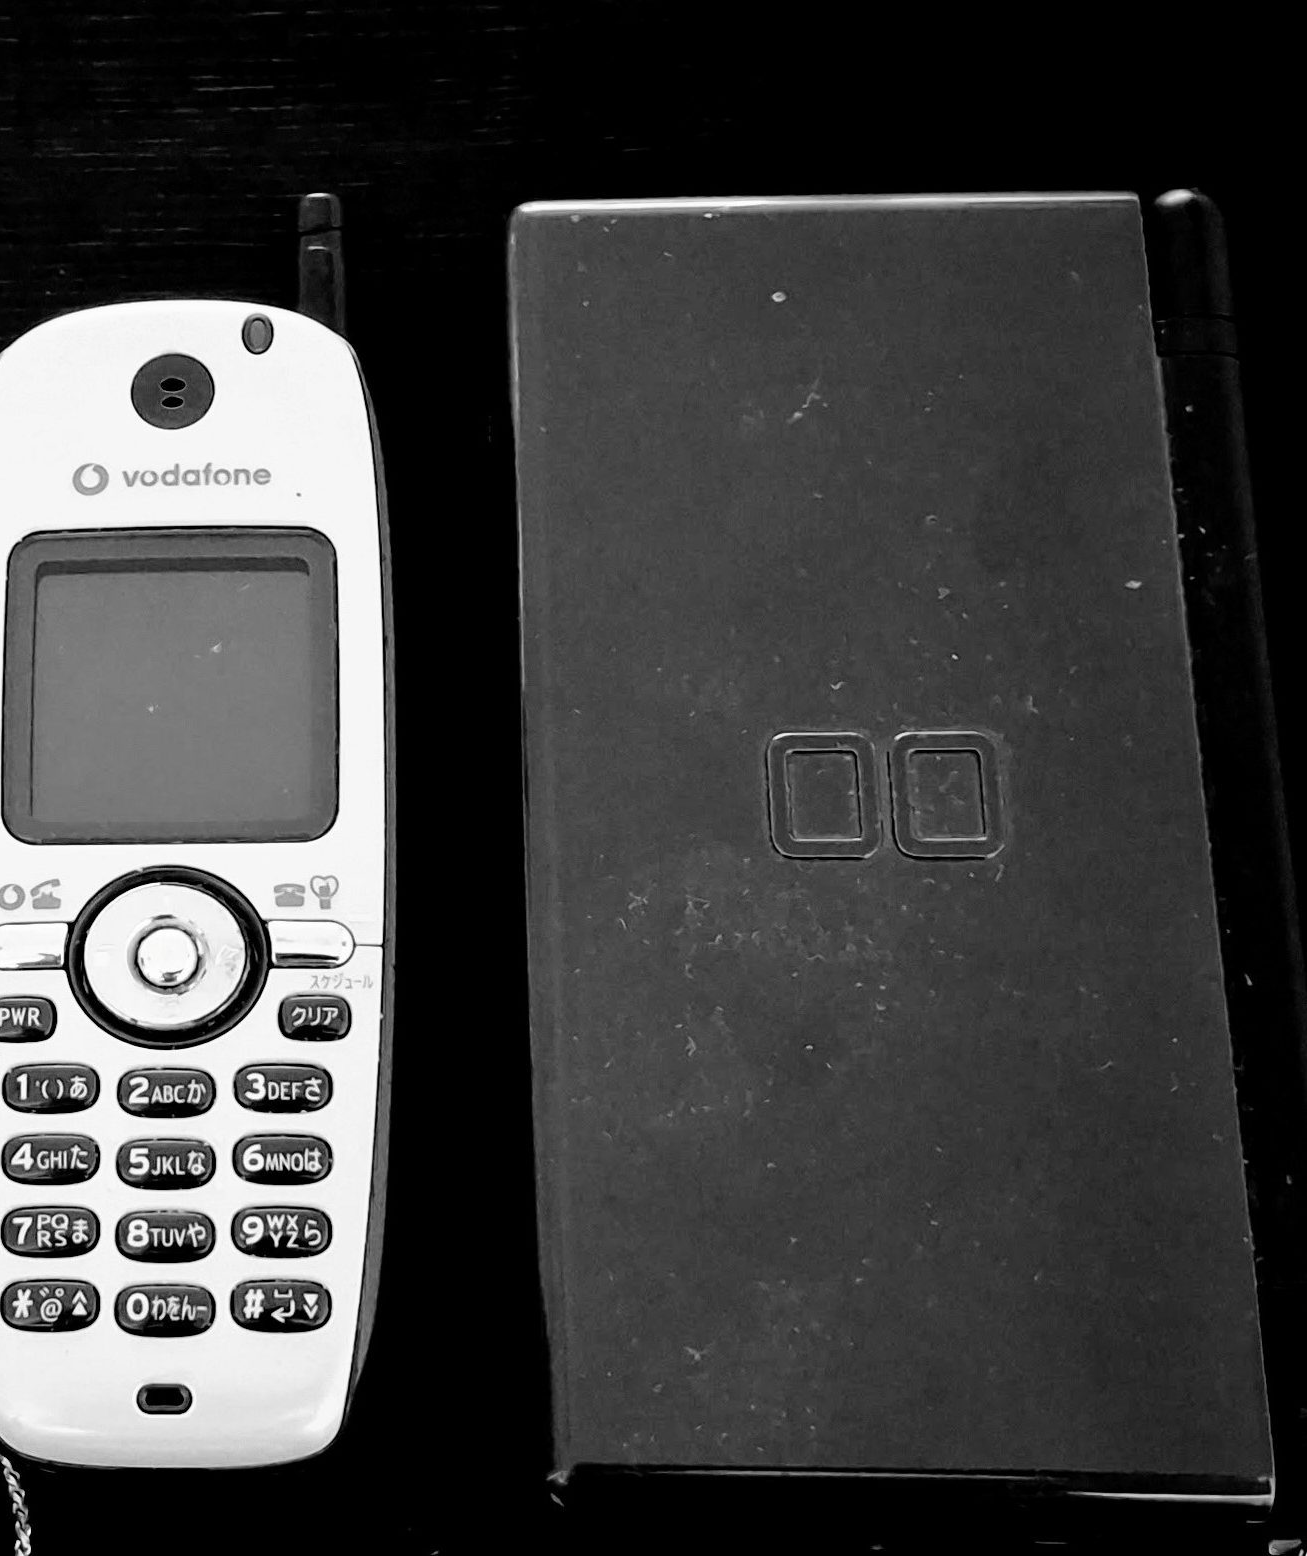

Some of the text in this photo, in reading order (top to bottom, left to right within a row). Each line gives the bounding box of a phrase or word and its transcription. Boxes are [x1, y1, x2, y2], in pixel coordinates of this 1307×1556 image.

[122, 463, 272, 487] vodafone
[310, 974, 373, 990] スケジュール
[291, 1006, 339, 1027] クリア
